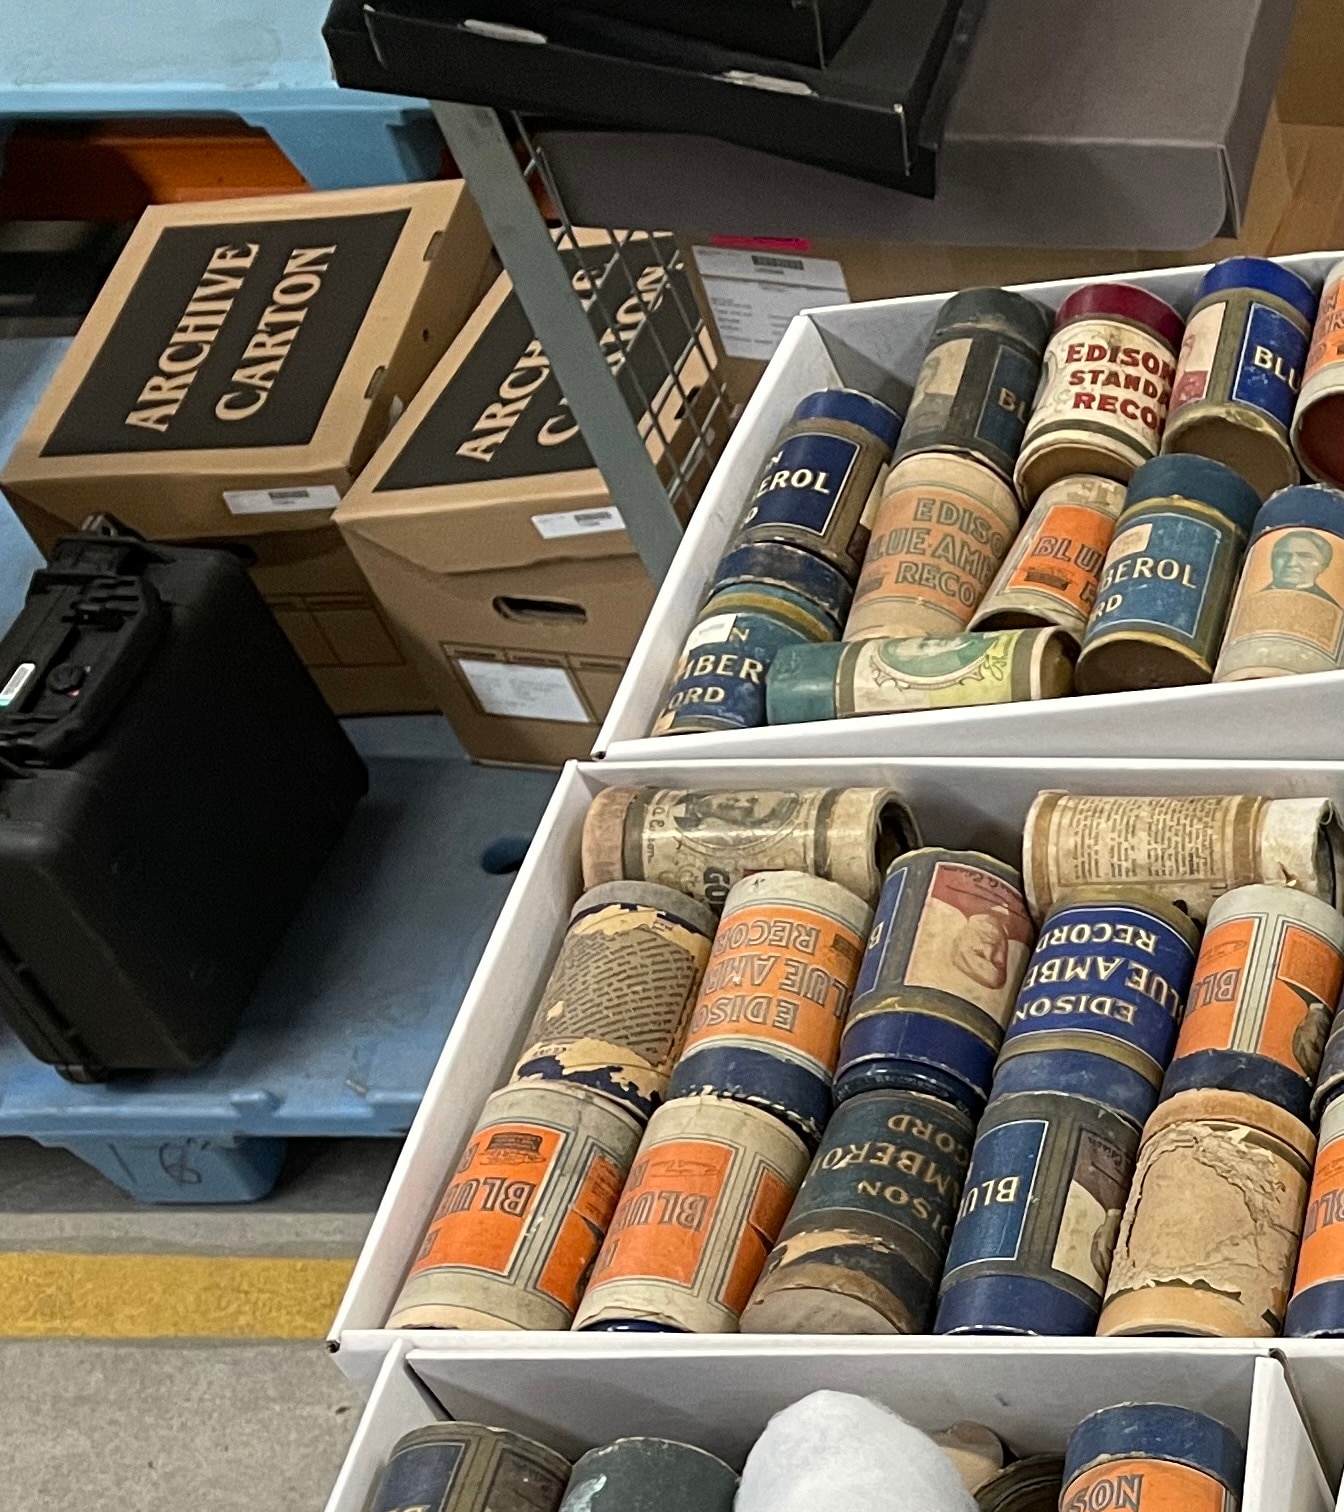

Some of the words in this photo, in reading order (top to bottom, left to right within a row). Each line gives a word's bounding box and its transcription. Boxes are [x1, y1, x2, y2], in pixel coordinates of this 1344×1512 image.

[125, 241, 260, 433] ARCHIVE
[214, 243, 337, 421] CARTON
[1066, 342, 1172, 380] EDISON
[1072, 392, 1163, 430] RECO
[1033, 922, 1161, 957] RECORD
[1013, 994, 1135, 1025] EDISON
